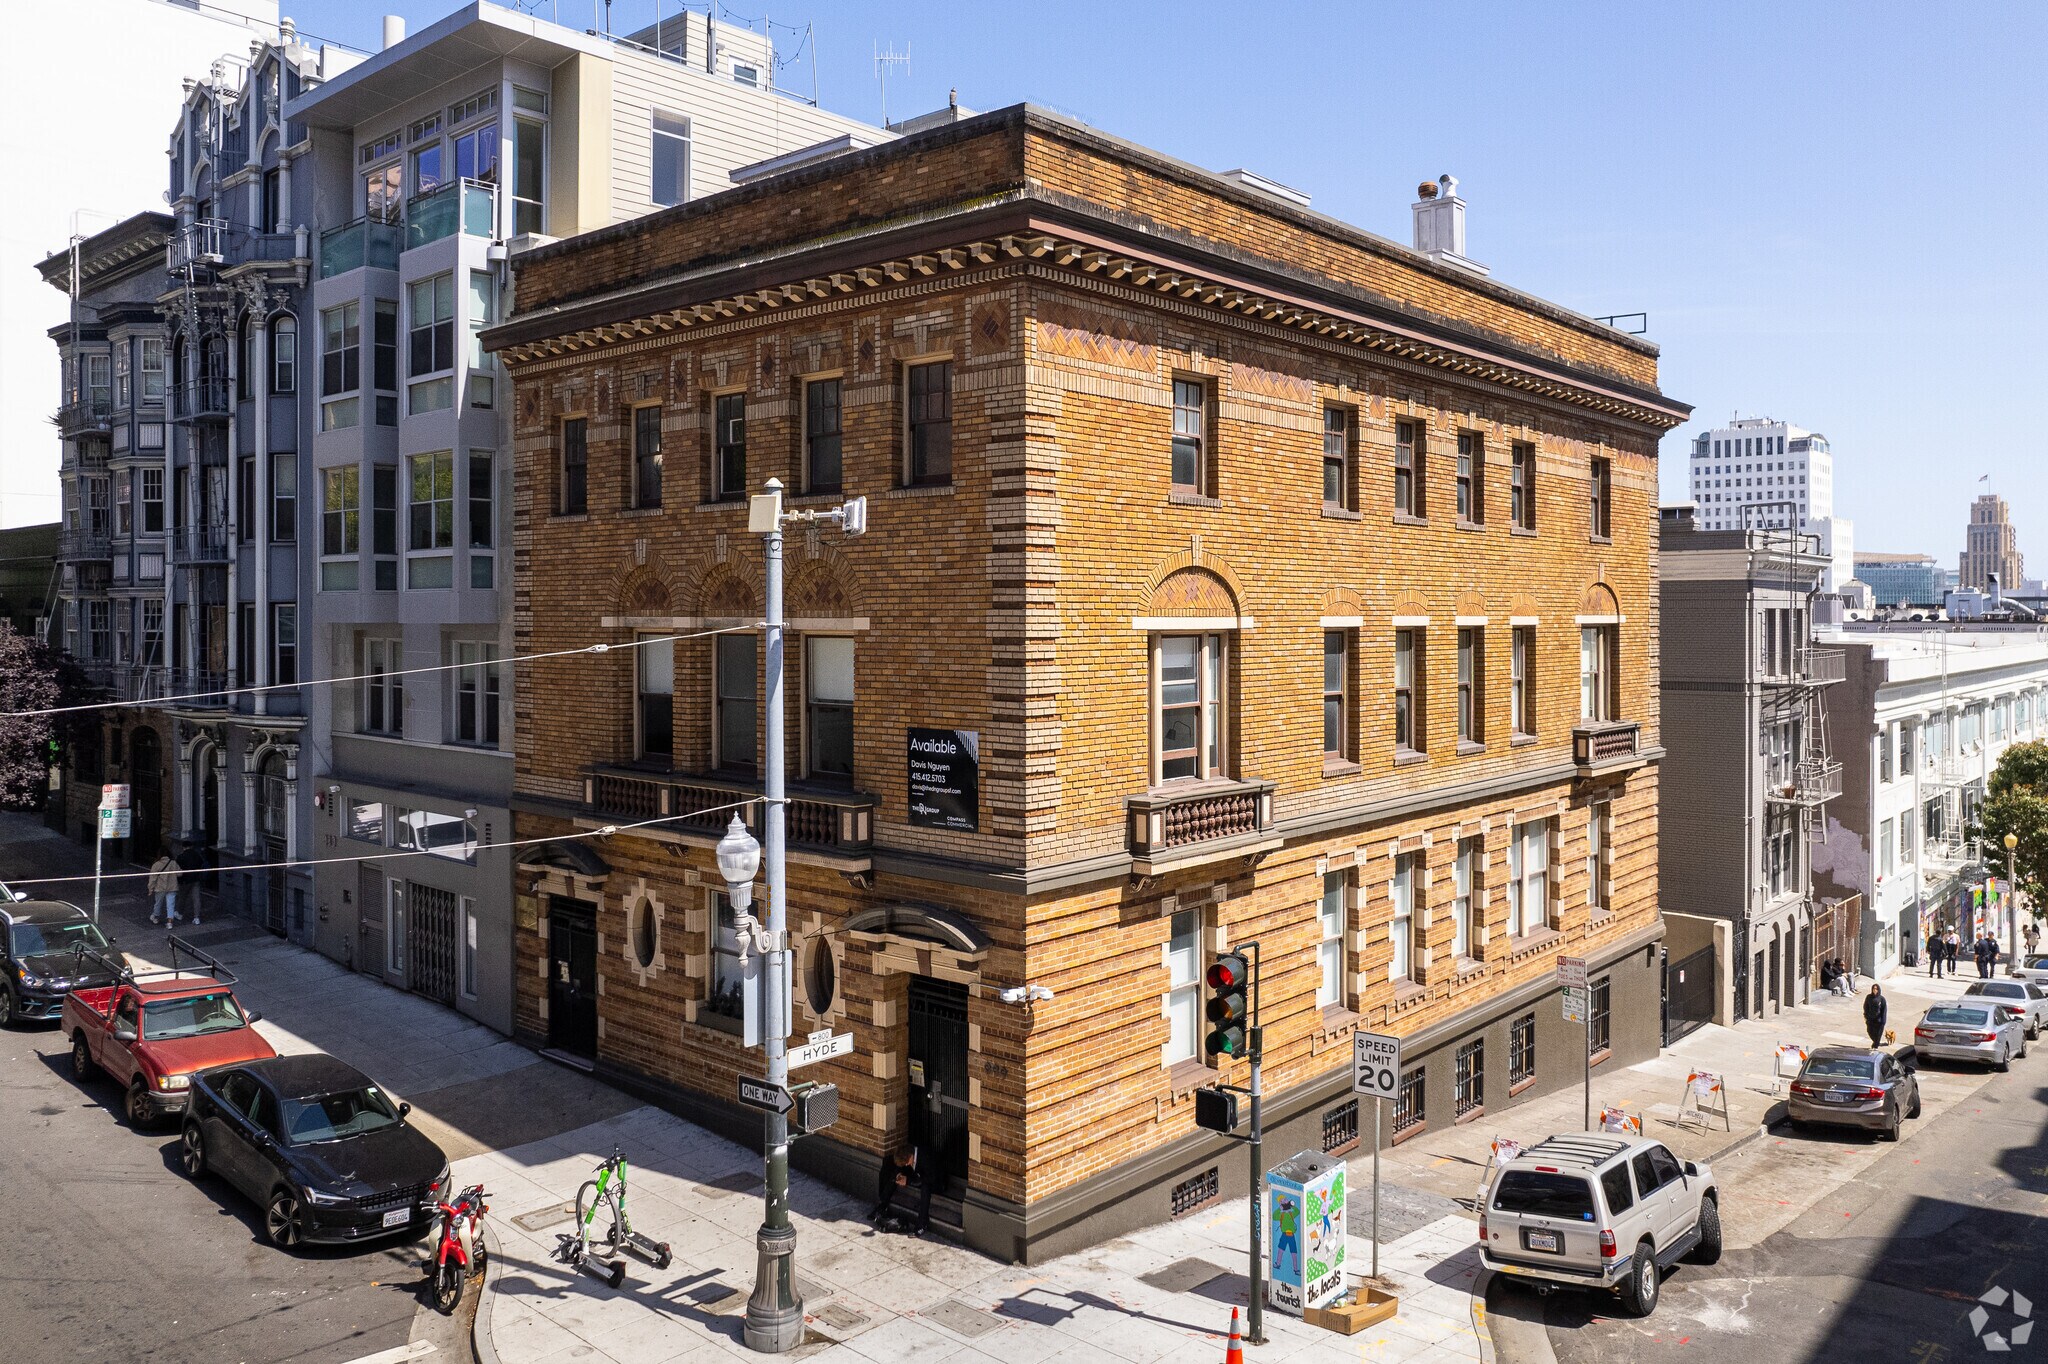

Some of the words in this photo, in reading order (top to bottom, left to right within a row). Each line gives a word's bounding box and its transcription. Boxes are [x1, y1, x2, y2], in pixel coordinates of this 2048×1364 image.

[910, 738, 957, 754] Available
[911, 760, 927, 769] Davis
[927, 762, 951, 772] Nguyen
[911, 772, 946, 783] 415.412.5703
[946, 821, 974, 829] COMMERCIAL
[1557, 956, 1566, 965] NO
[1566, 959, 1585, 968] PARKING
[1563, 986, 1569, 995] 2
[803, 1041, 838, 1061] HYDE
[1357, 1038, 1397, 1054] SPEED
[1361, 1052, 1392, 1067] LIMIT
[1358, 1065, 1395, 1092] 20
[743, 1085, 760, 1099] ONE
[761, 1090, 779, 1104] WAY
[1281, 1281, 1293, 1294] the
[1307, 1284, 1319, 1303] the
[1320, 1269, 1341, 1296] locals
[1275, 1289, 1301, 1309] tourist
